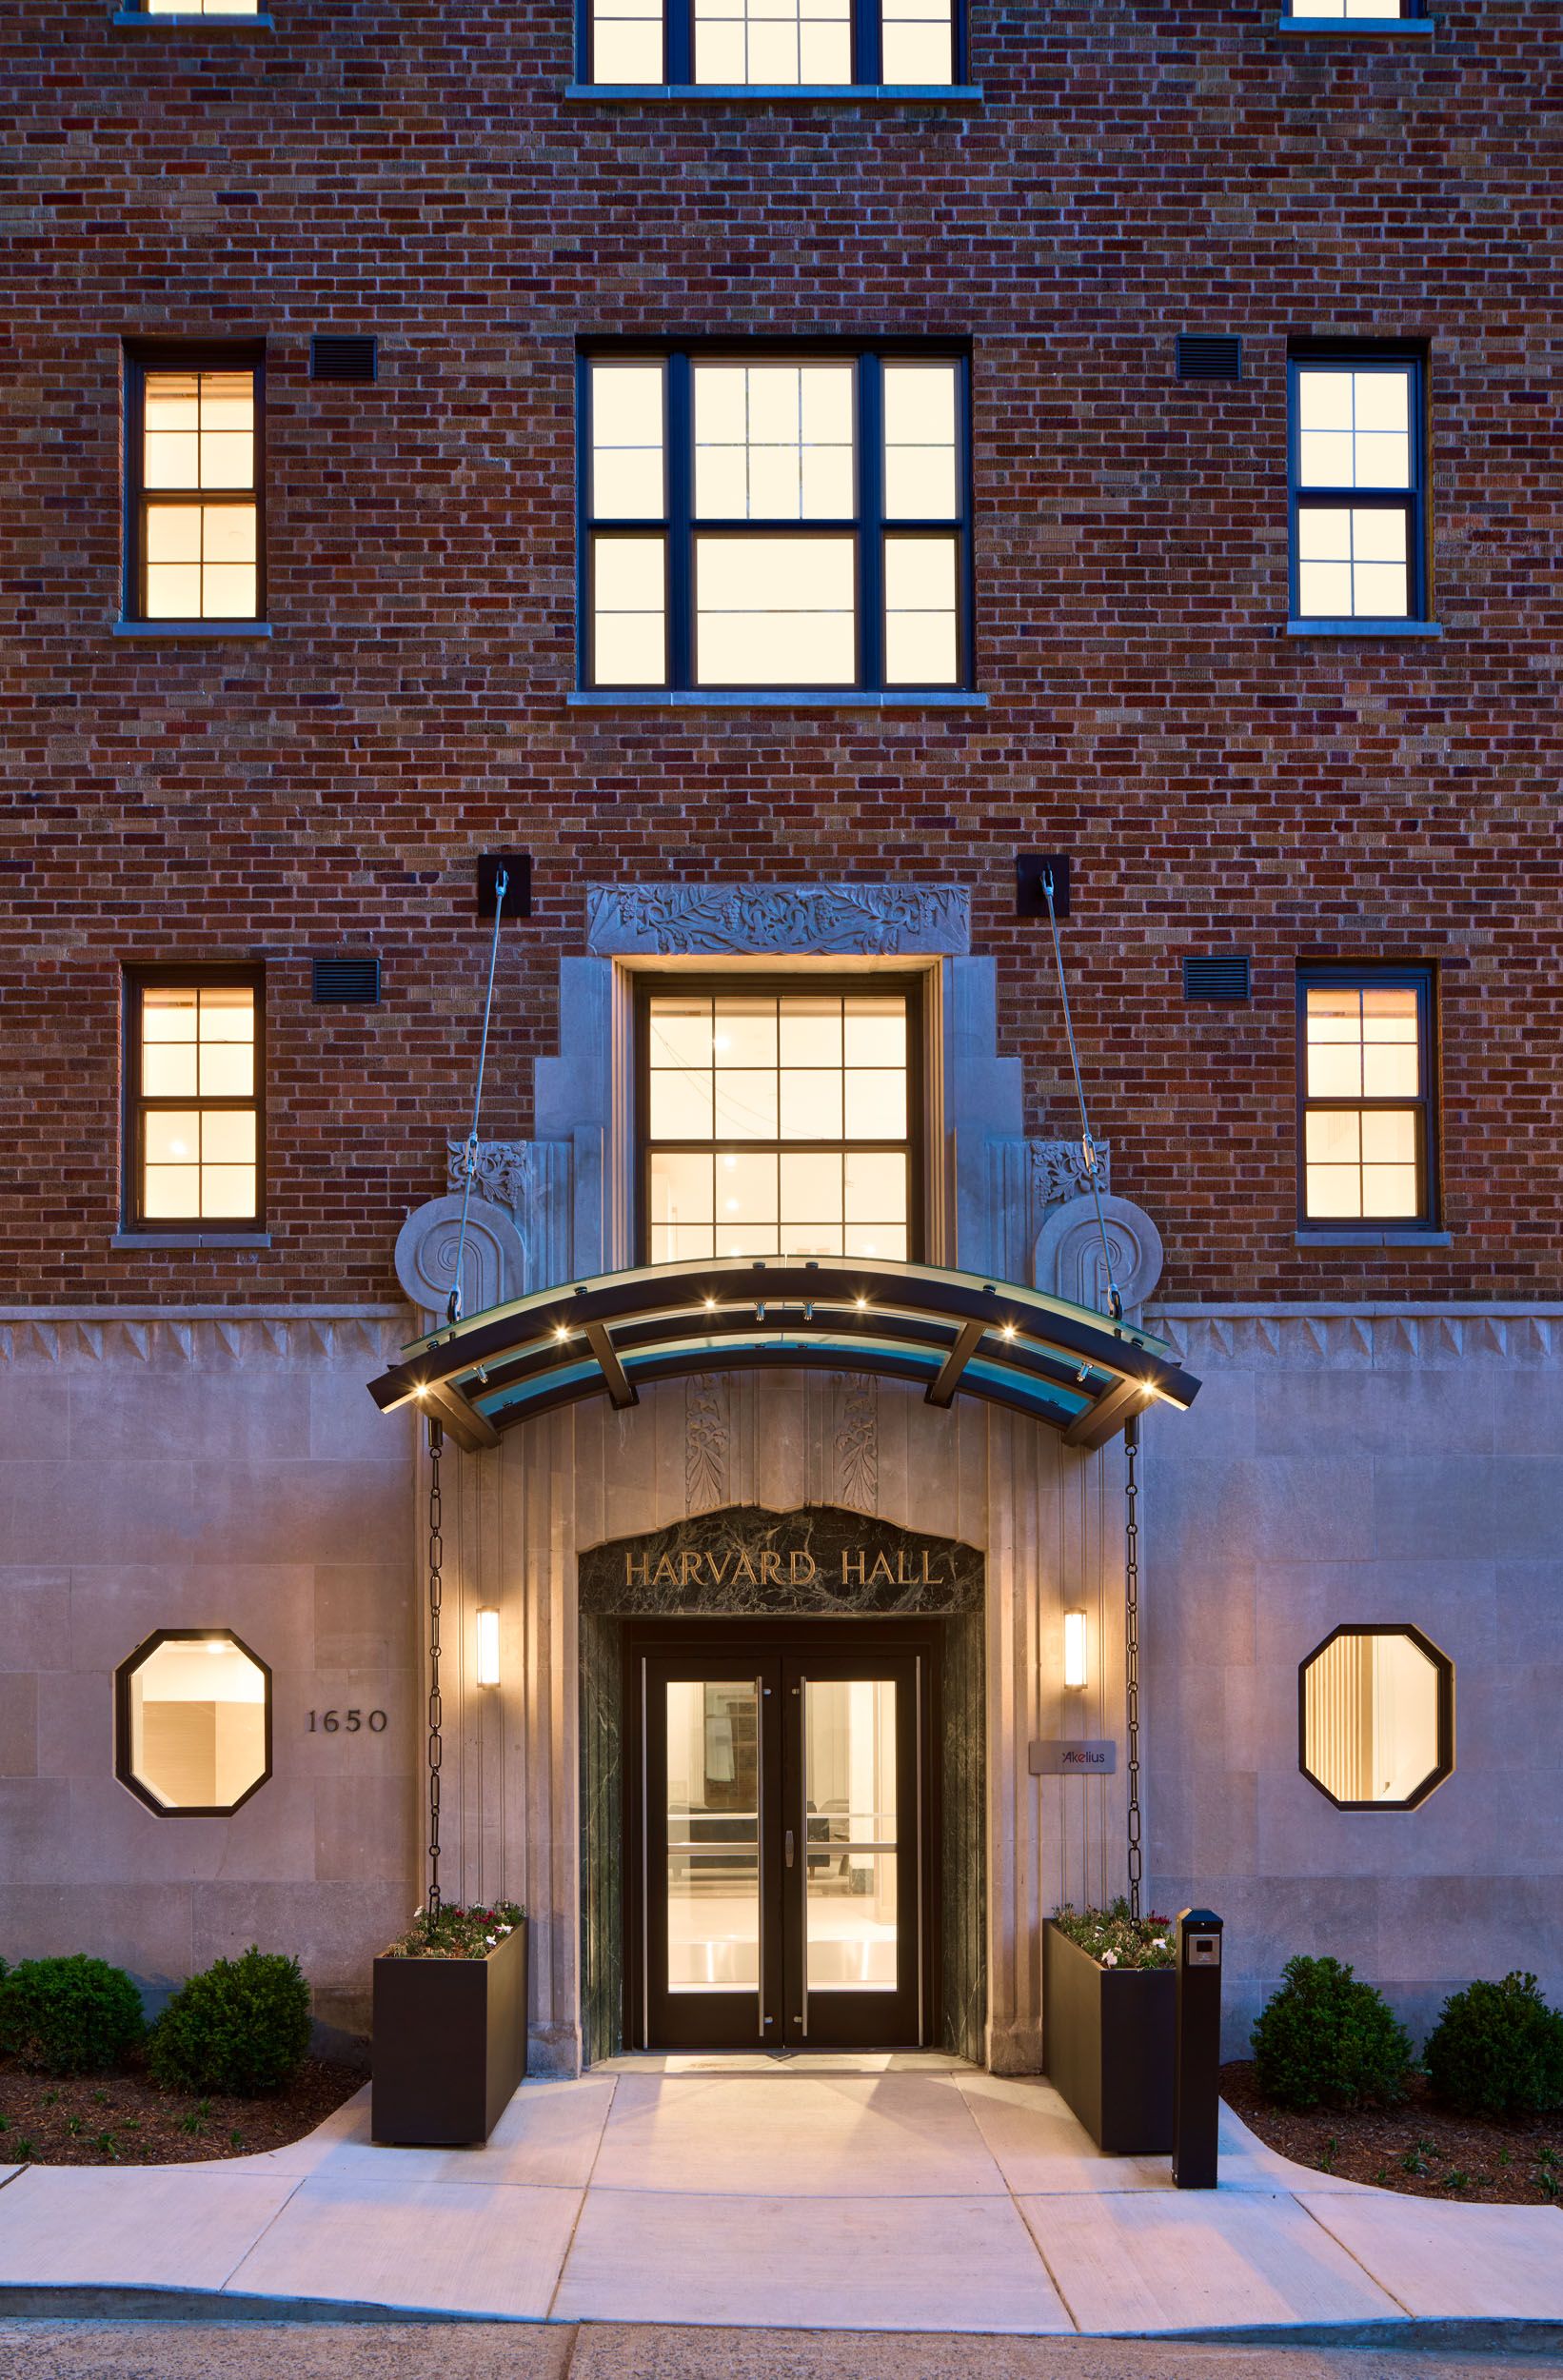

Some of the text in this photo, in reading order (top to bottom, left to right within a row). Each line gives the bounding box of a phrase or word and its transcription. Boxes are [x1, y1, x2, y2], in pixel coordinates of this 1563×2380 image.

[624, 1549, 944, 1586] HARVARD HALL
[307, 1709, 387, 1733] 1650
[1061, 1751, 1105, 1763] Akelius
